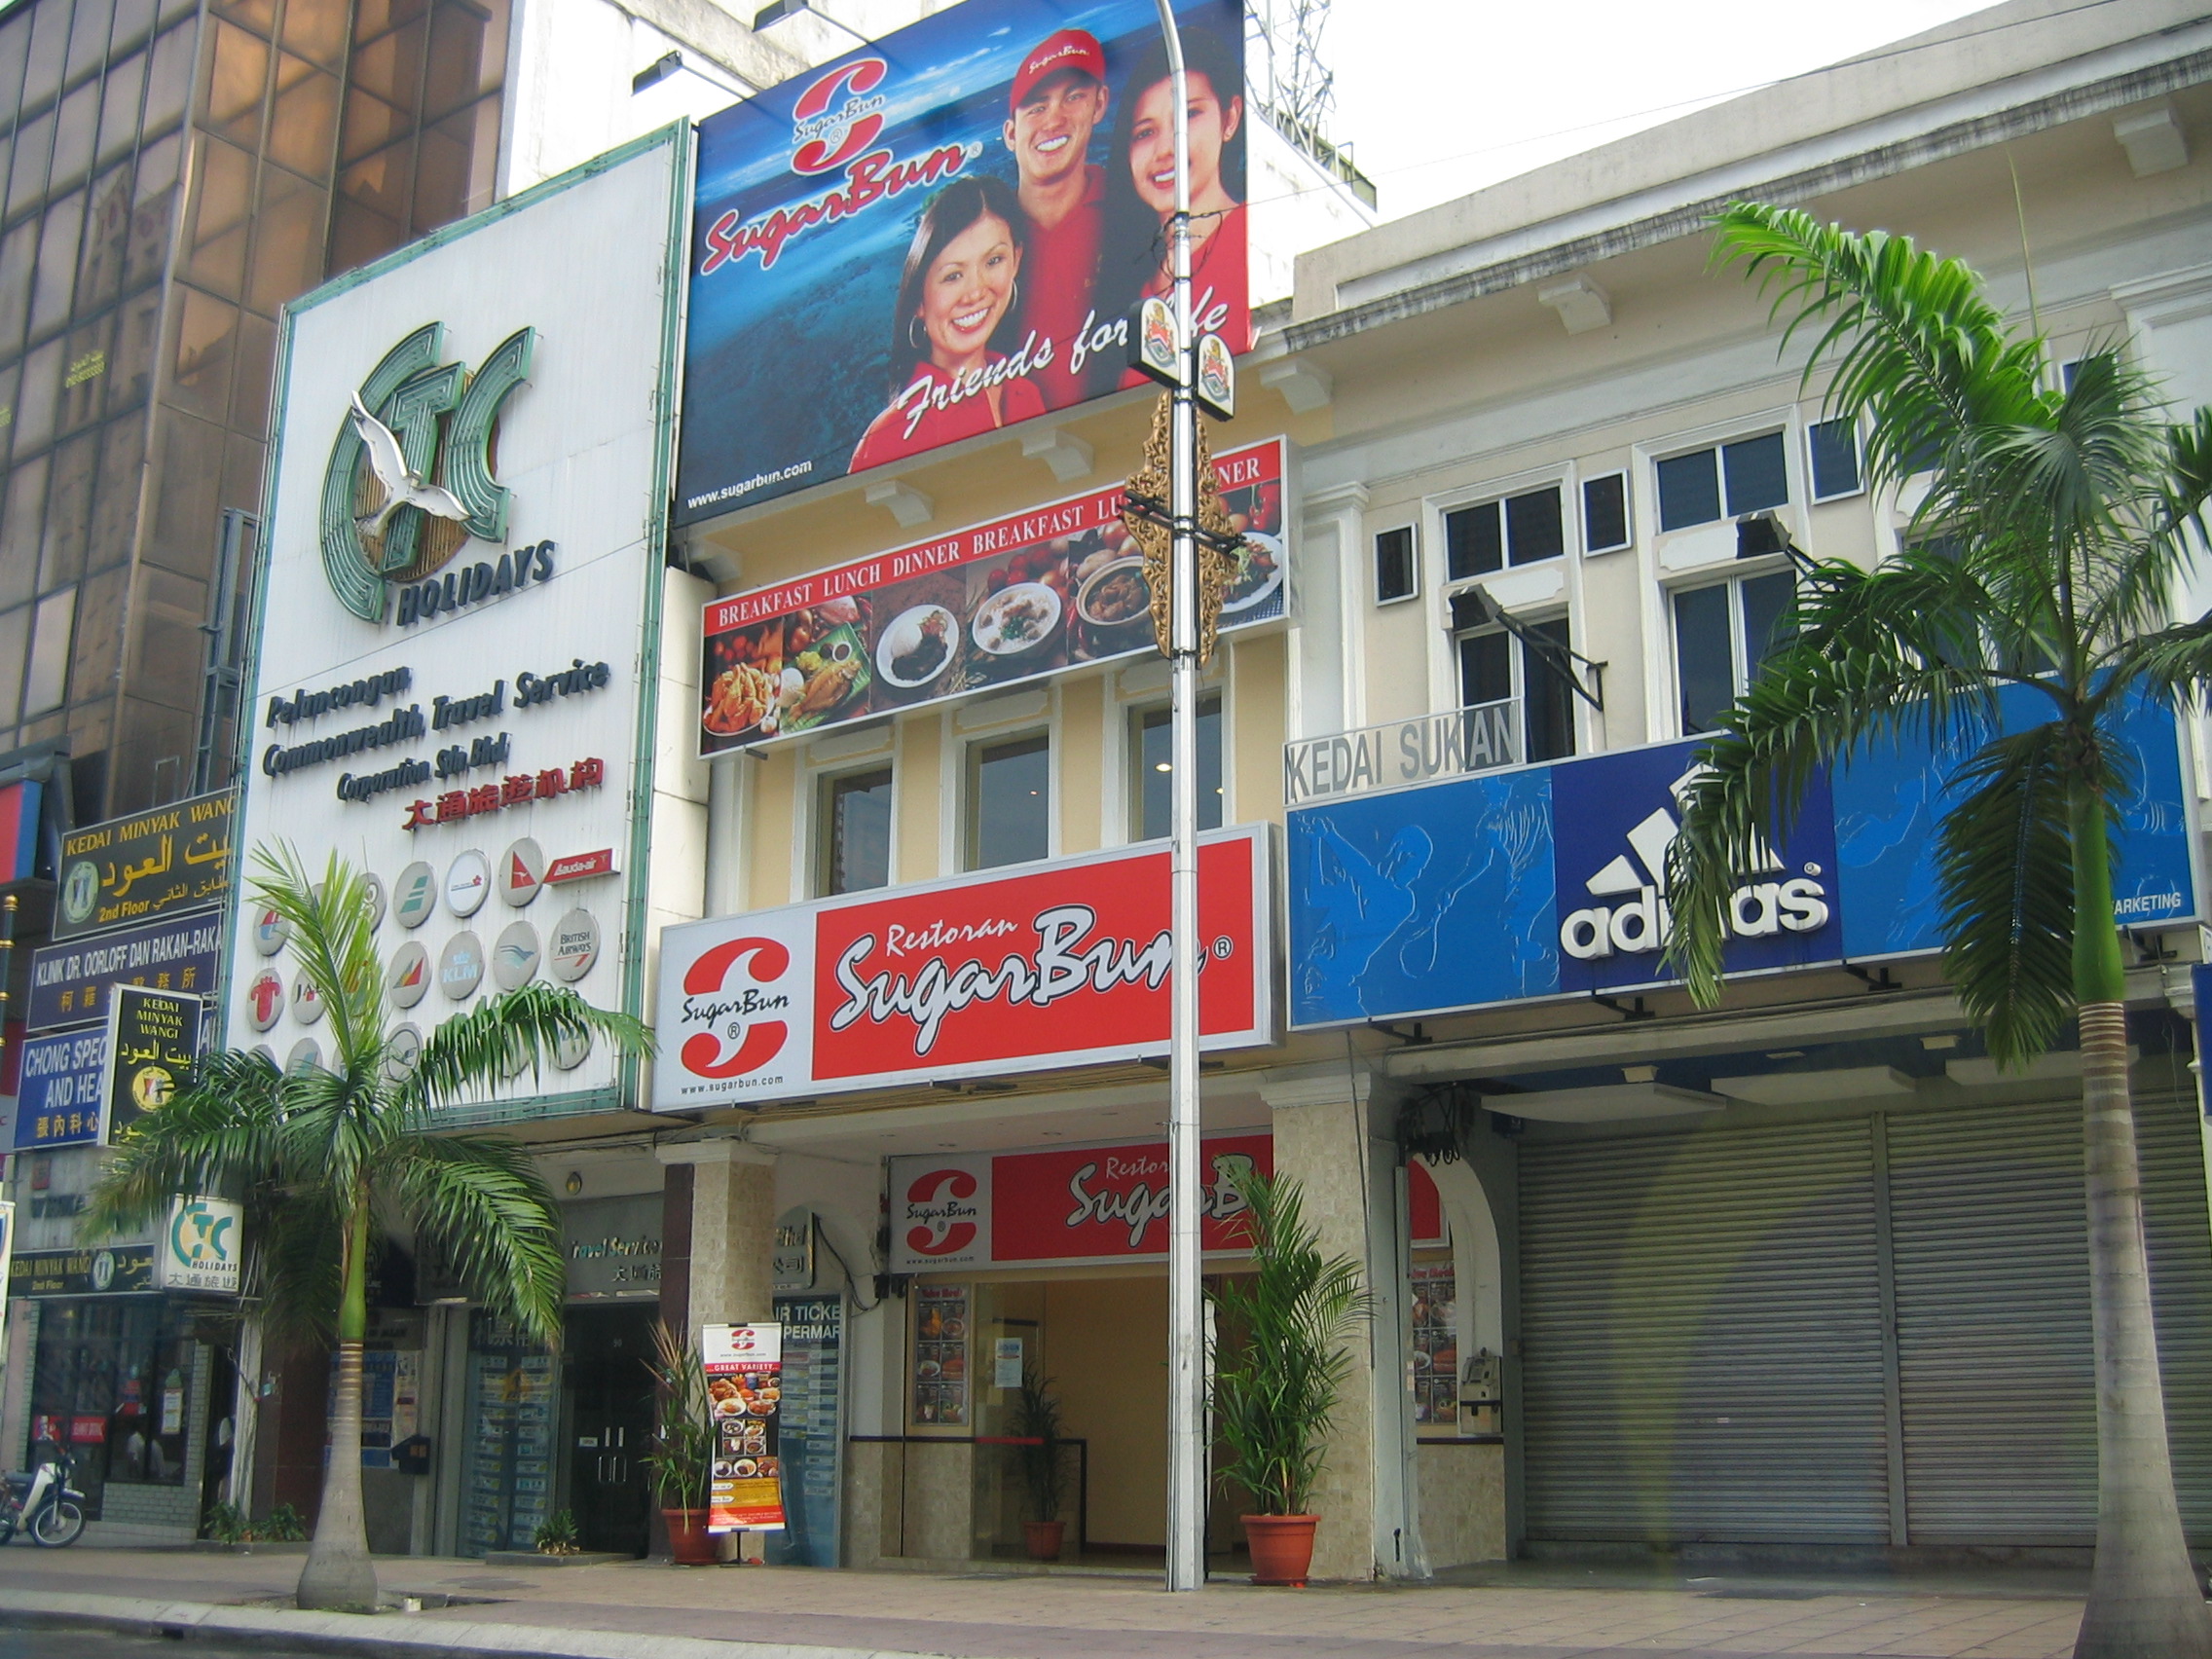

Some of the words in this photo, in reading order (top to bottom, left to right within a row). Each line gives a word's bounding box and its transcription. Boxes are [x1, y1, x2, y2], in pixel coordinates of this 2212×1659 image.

[793, 95, 884, 143] SugarBun
[700, 140, 971, 276] SugarBun
[897, 329, 1054, 439] Friends
[1070, 309, 1129, 375] for
[687, 459, 812, 509] www.sugarbun.com
[719, 586, 813, 628] BREAKFAST
[823, 563, 882, 598] LUNCH
[892, 540, 961, 578] DINNER
[973, 507, 1084, 555] BREAKFAST
[1217, 456, 1261, 486] NER
[396, 539, 557, 626] HOLIDAYS
[266, 665, 413, 729] Pelancongan
[262, 703, 426, 778] Commonwealth
[431, 679, 504, 731] Travel
[512, 658, 610, 708] Service
[337, 757, 430, 803] Corporation
[434, 744, 468, 779] Sdn
[1289, 730, 1382, 804] KEDAI
[1400, 708, 1514, 780] SUKAN
[66, 830, 111, 857] KEDAI
[119, 811, 180, 843] MINYAK
[98, 904, 119, 923] 2nd
[122, 901, 150, 918] Floor
[1560, 877, 1829, 961] adias
[2113, 892, 2182, 916] ARKETING
[36, 958, 63, 987] KLINIK
[66, 954, 82, 980] DR.
[85, 944, 129, 977] OORLOFF
[129, 940, 150, 969] DAN
[152, 926, 224, 964] RAKAN-RAKA
[557, 942, 592, 956] AIRWAYS
[560, 931, 591, 945] BRITISH
[886, 918, 1019, 959] Restoran
[442, 964, 479, 983] KLM
[135, 1009, 184, 1027] MINYAK
[143, 998, 181, 1014] KEDAI
[681, 988, 790, 1030] SugarBun
[139, 1023, 179, 1040] WANGI
[25, 1042, 71, 1079] CHONG
[45, 1076, 74, 1110] AND
[681, 1075, 784, 1096] www.sugarbun.com
[905, 1200, 977, 1225] SugarBun
[192, 1260, 238, 1272] HOLIDAYS
[776, 1306, 791, 1321] IR
